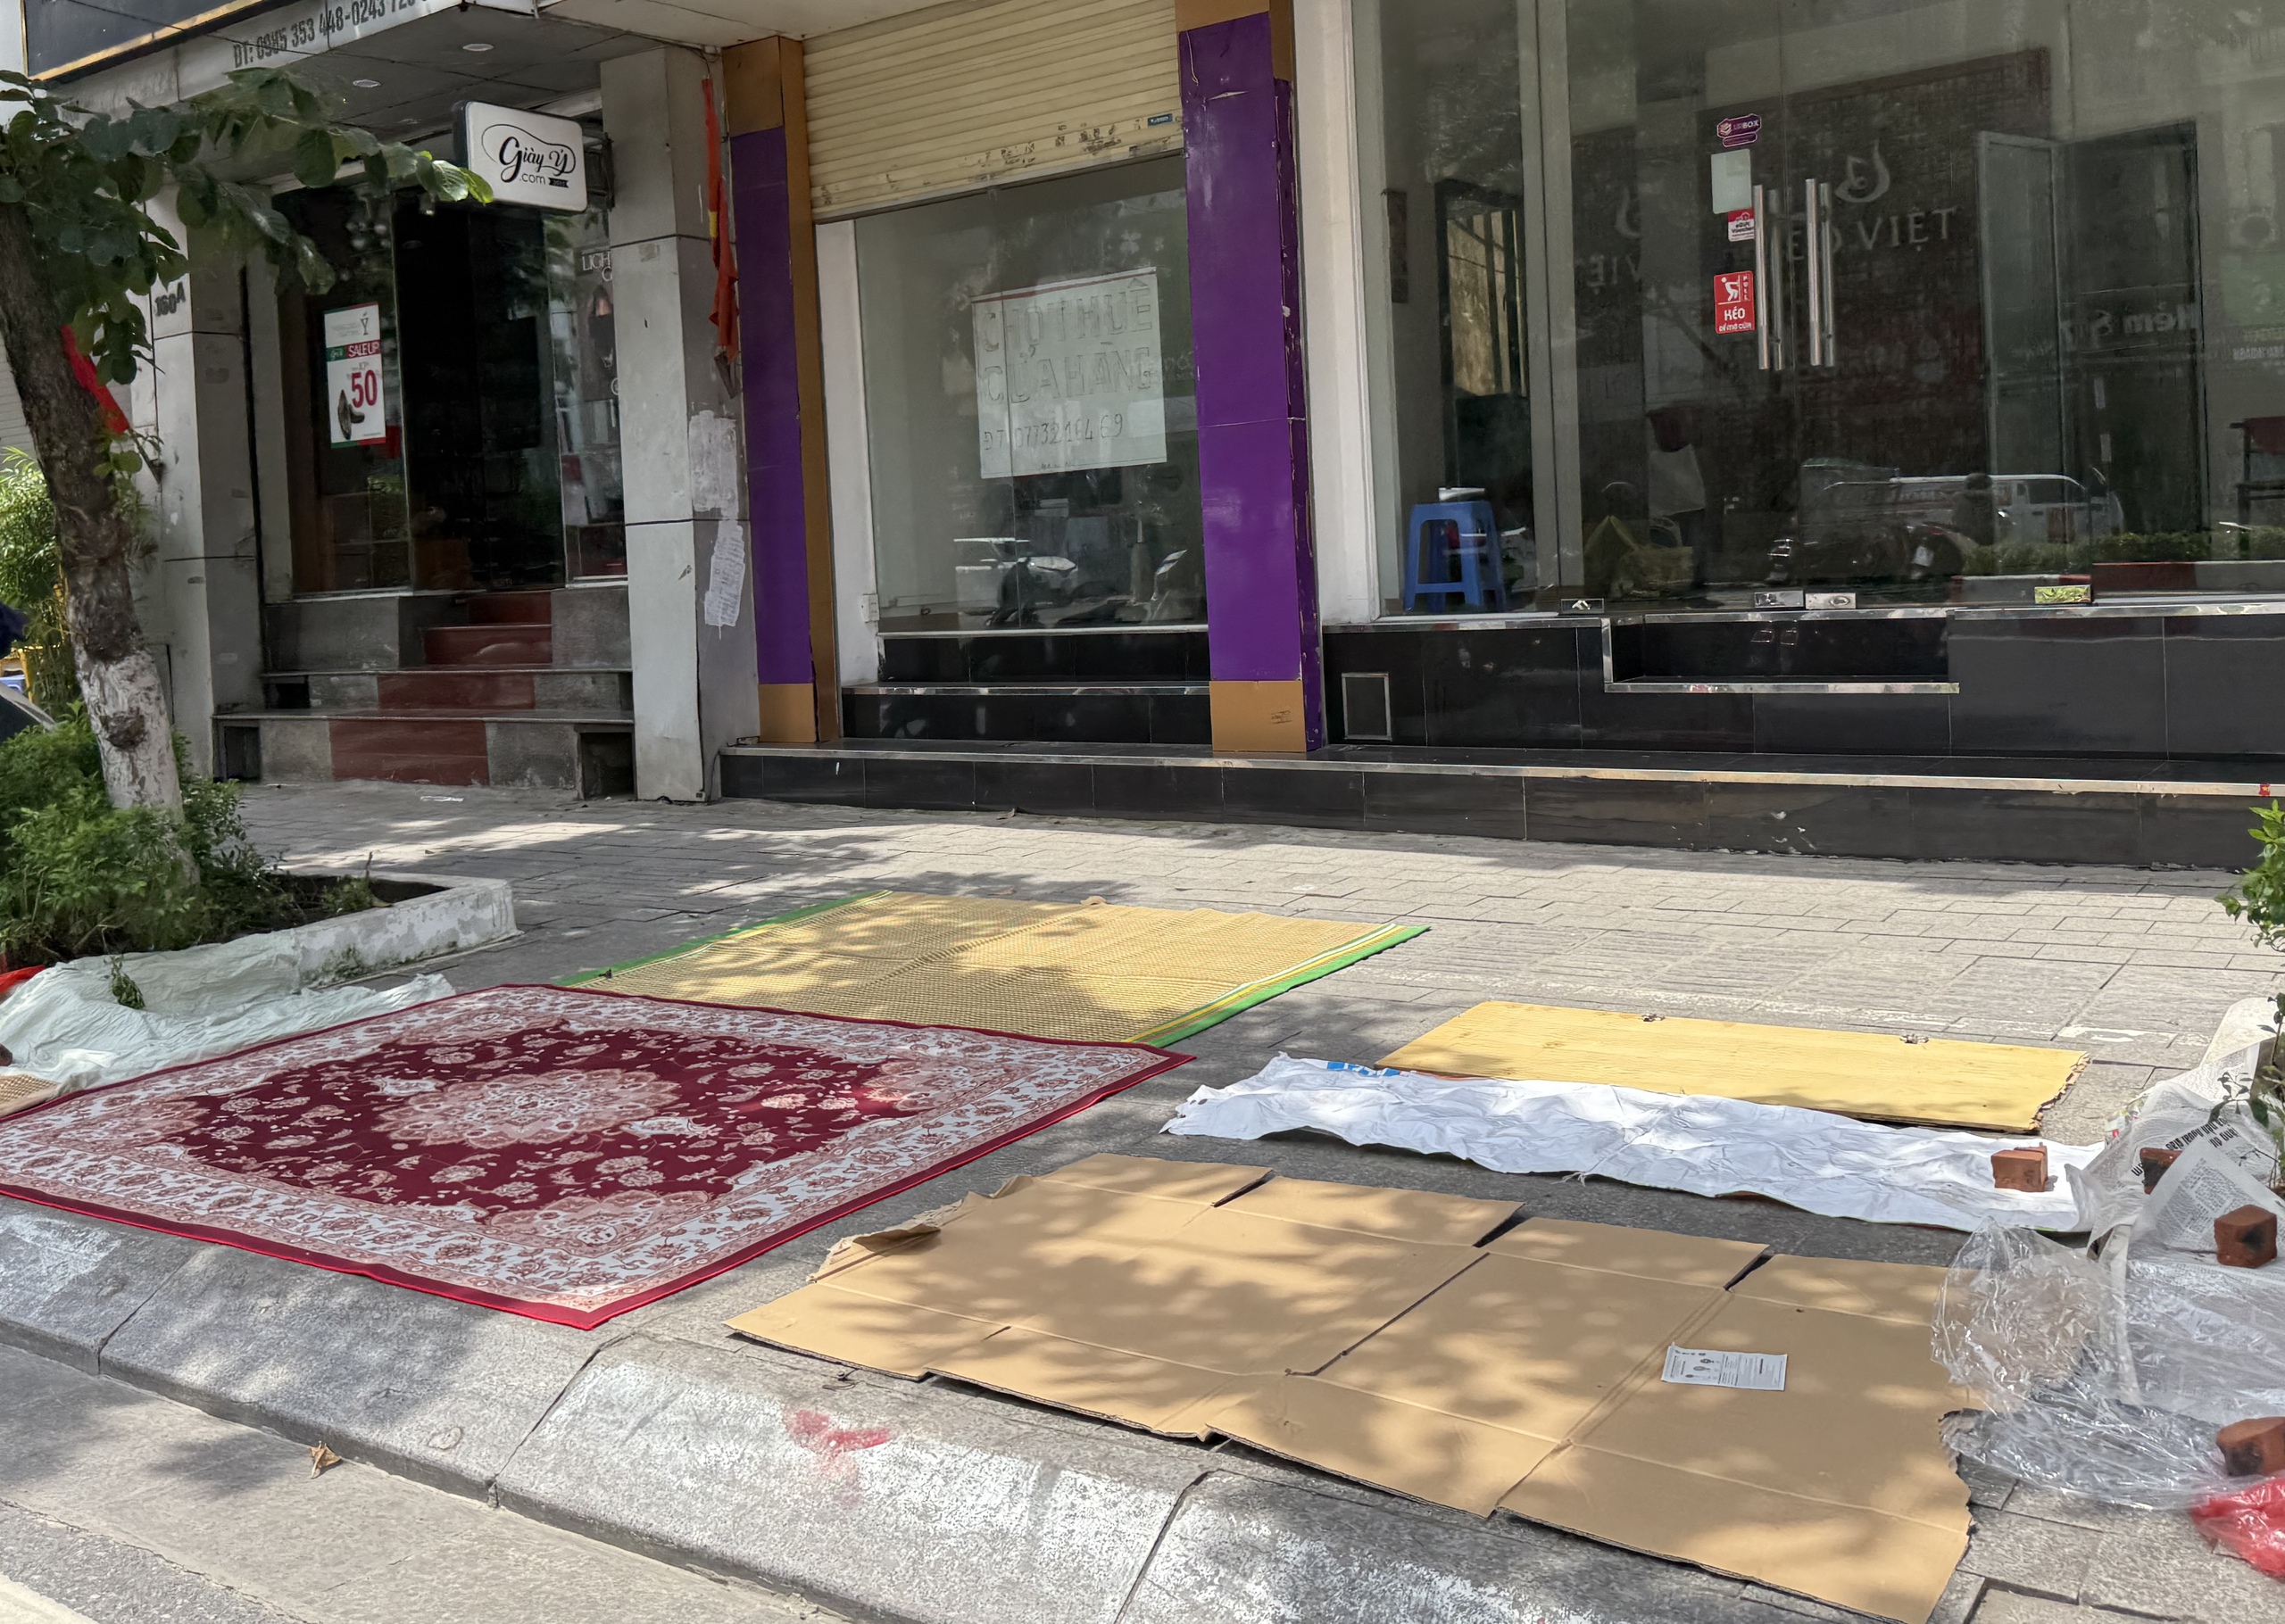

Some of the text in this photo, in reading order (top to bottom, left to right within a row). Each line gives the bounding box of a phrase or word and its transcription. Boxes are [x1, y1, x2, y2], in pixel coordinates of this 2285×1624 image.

[291, 18, 315, 47] 353
[498, 136, 544, 184] Giày
[519, 172, 546, 186] .com
[1856, 204, 1962, 253] VIỆT
[581, 251, 611, 271] LIGH
[980, 278, 1153, 353] CHO THUÊ
[1724, 305, 1746, 321] KÉO
[351, 369, 378, 408] 50
